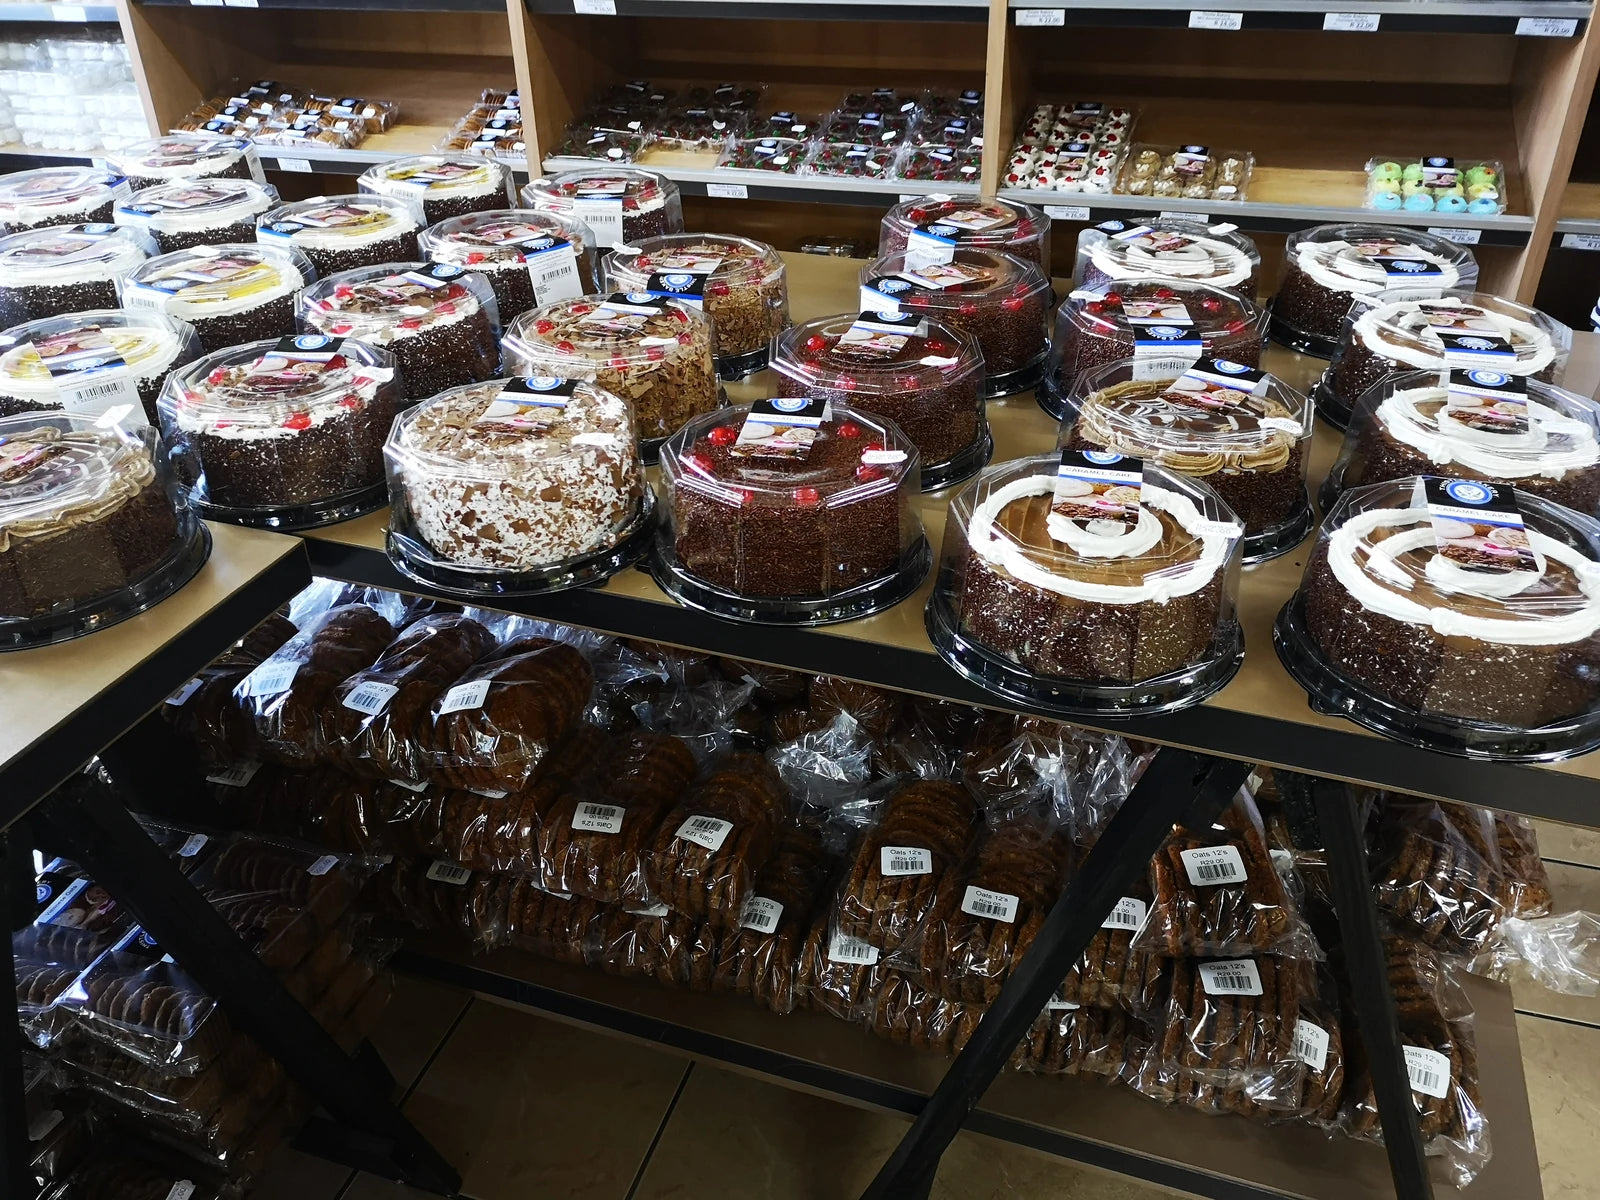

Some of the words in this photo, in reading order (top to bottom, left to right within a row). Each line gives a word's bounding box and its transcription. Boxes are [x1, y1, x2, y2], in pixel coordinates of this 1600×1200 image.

[1065, 467, 1106, 476] CARAMEL
[1435, 506, 1480, 516] CARAMEL
[1484, 511, 1512, 519] CAKE
[596, 821, 612, 829] Oats
[699, 833, 714, 844] Oats
[1191, 851, 1210, 859] Oats
[65, 885, 78, 897] Oats
[976, 890, 992, 899] Oats
[762, 901, 774, 909] 12's
[1121, 900, 1136, 908] 12's
[1307, 1026, 1320, 1039] 12's
[1404, 1049, 1422, 1058] Oats
[1425, 1054, 1441, 1064] 12's
